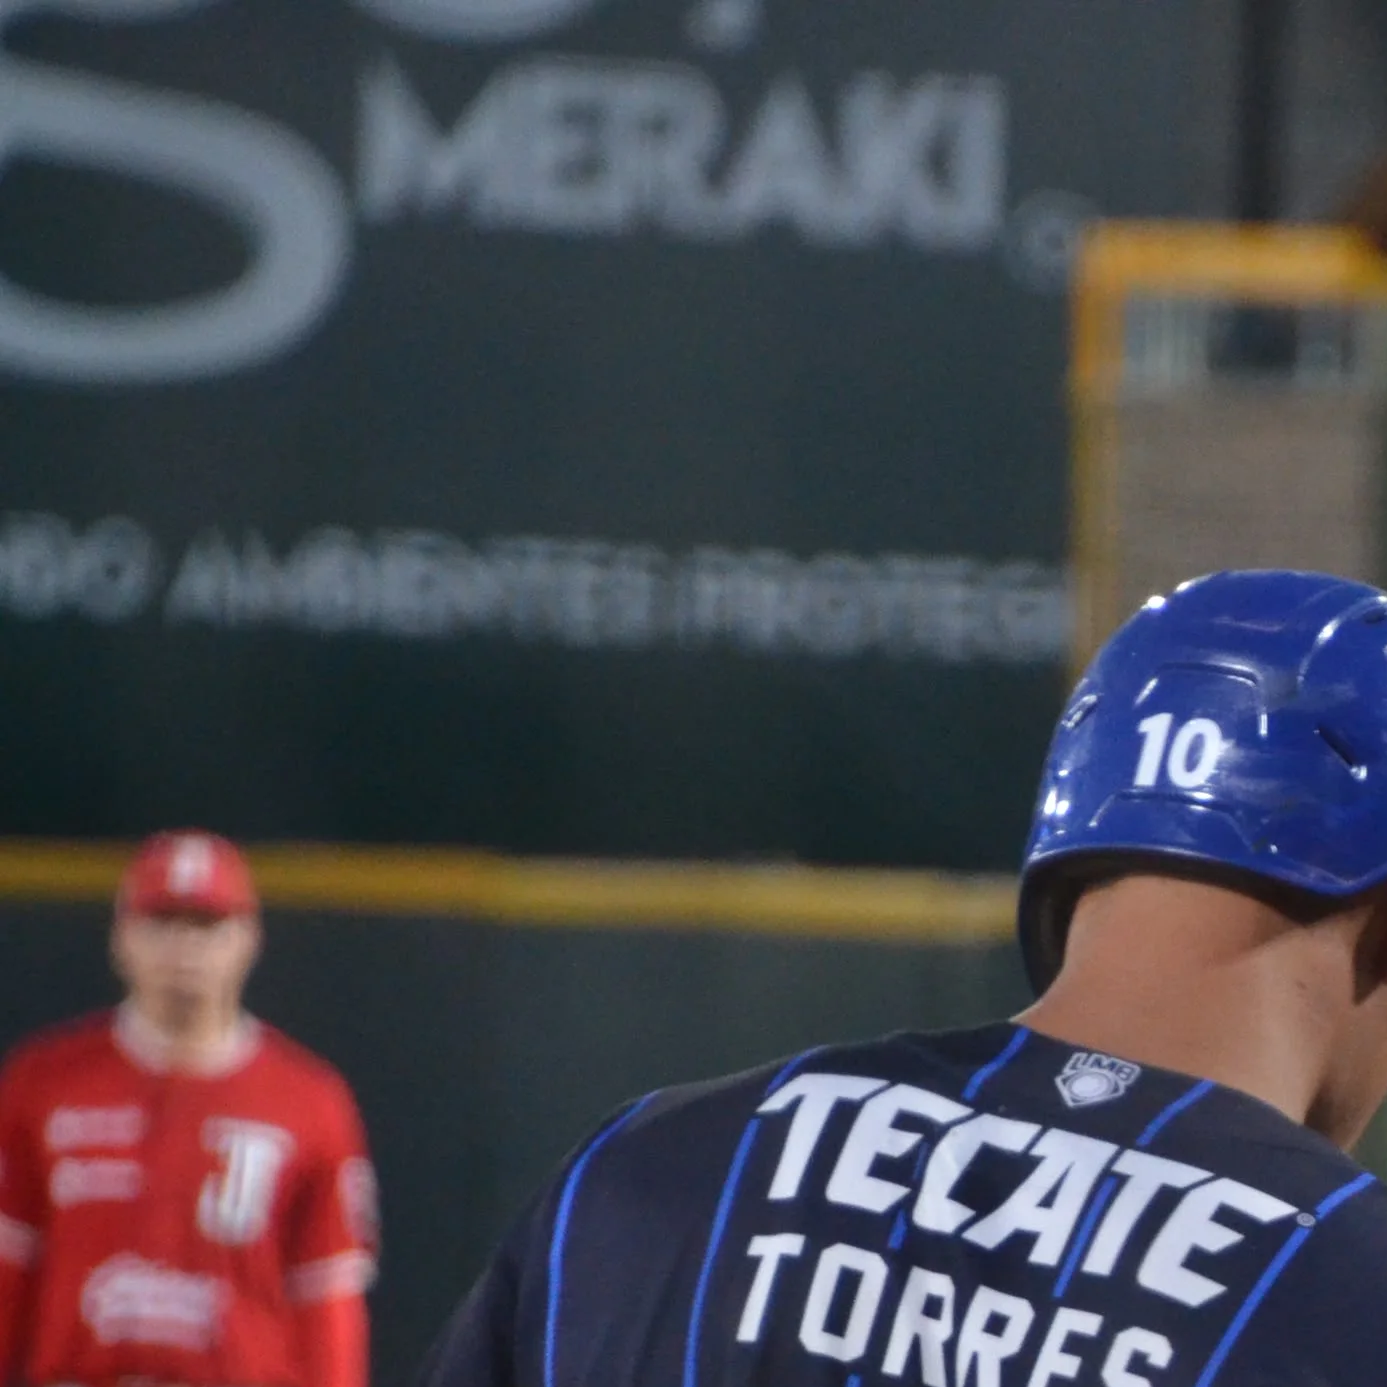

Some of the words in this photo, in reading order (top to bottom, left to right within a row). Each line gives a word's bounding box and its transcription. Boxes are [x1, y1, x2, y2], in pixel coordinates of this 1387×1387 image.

[355, 52, 1008, 252] MERAKI
[164, 522, 670, 648] AMBIENTES
[1132, 713, 1222, 788] 10
[757, 1072, 1302, 1308] TECATE
